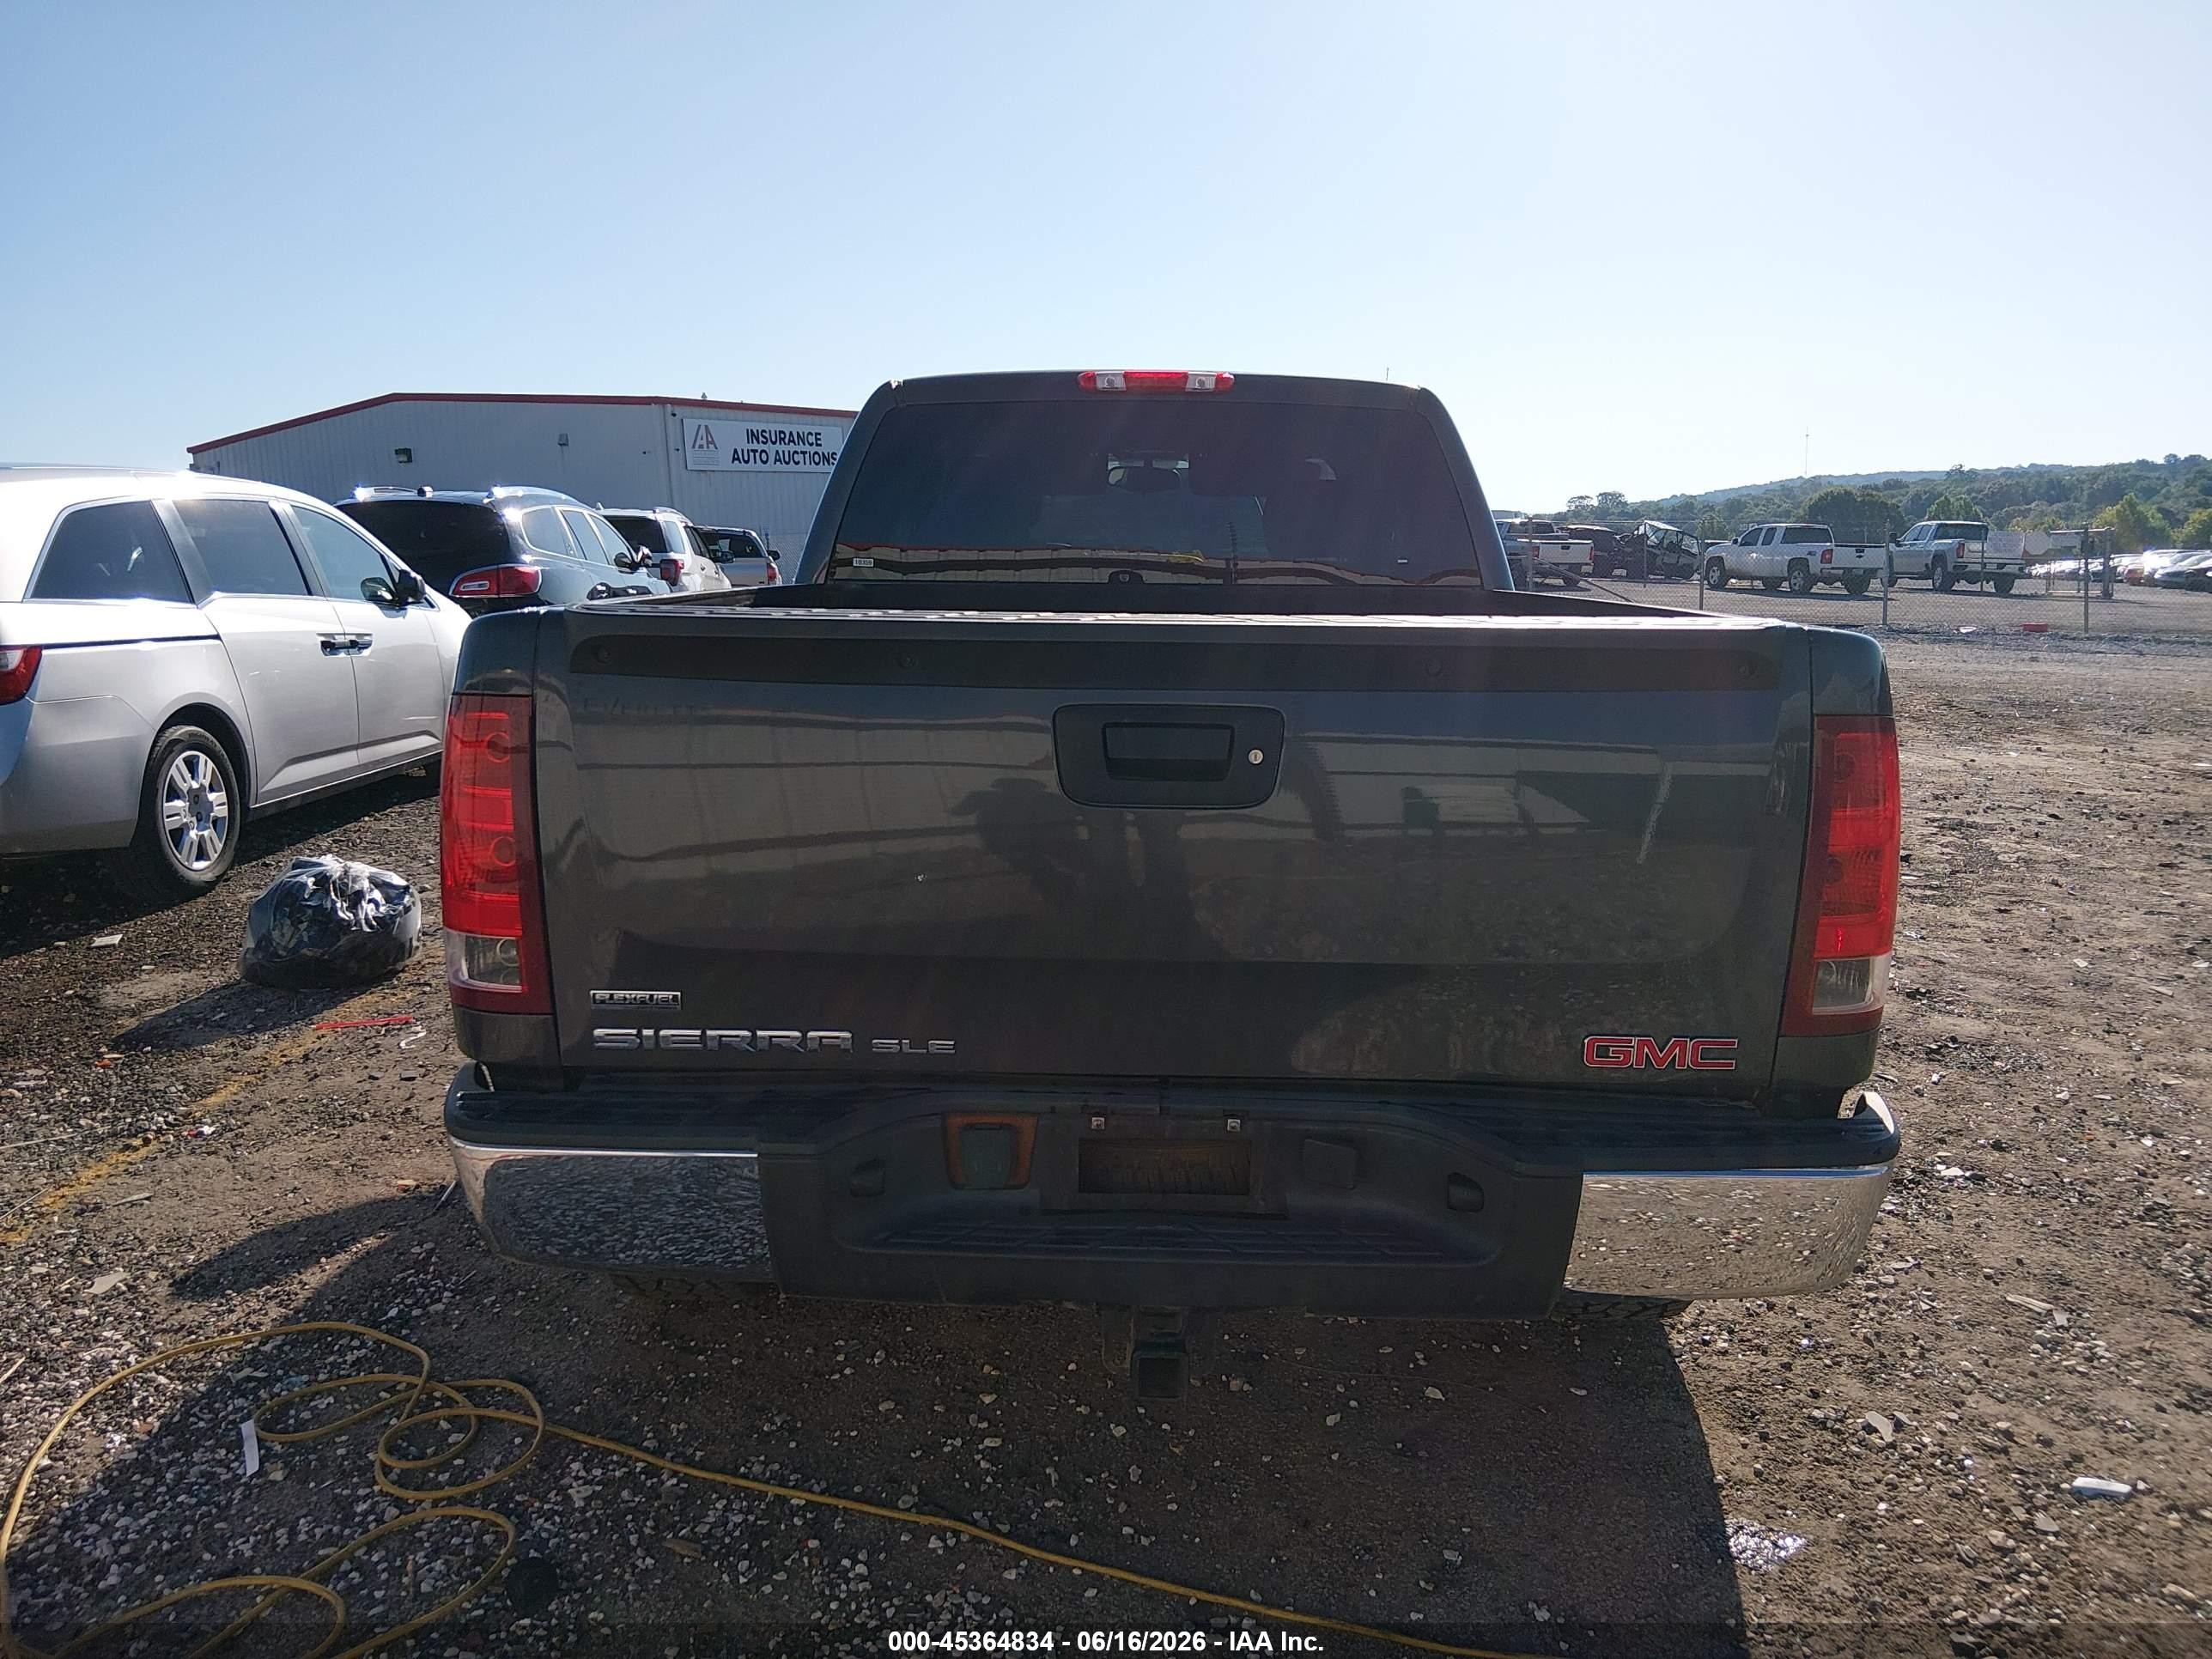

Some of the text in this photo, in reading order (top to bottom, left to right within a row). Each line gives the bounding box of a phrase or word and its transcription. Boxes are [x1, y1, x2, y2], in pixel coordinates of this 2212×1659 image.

[746, 428, 823, 447] INSURANCE
[732, 448, 769, 465] AUTO
[774, 450, 838, 466] AUCTIONS
[592, 1028, 956, 1054] SIERRA SLE
[1583, 1036, 1739, 1070] GMC
